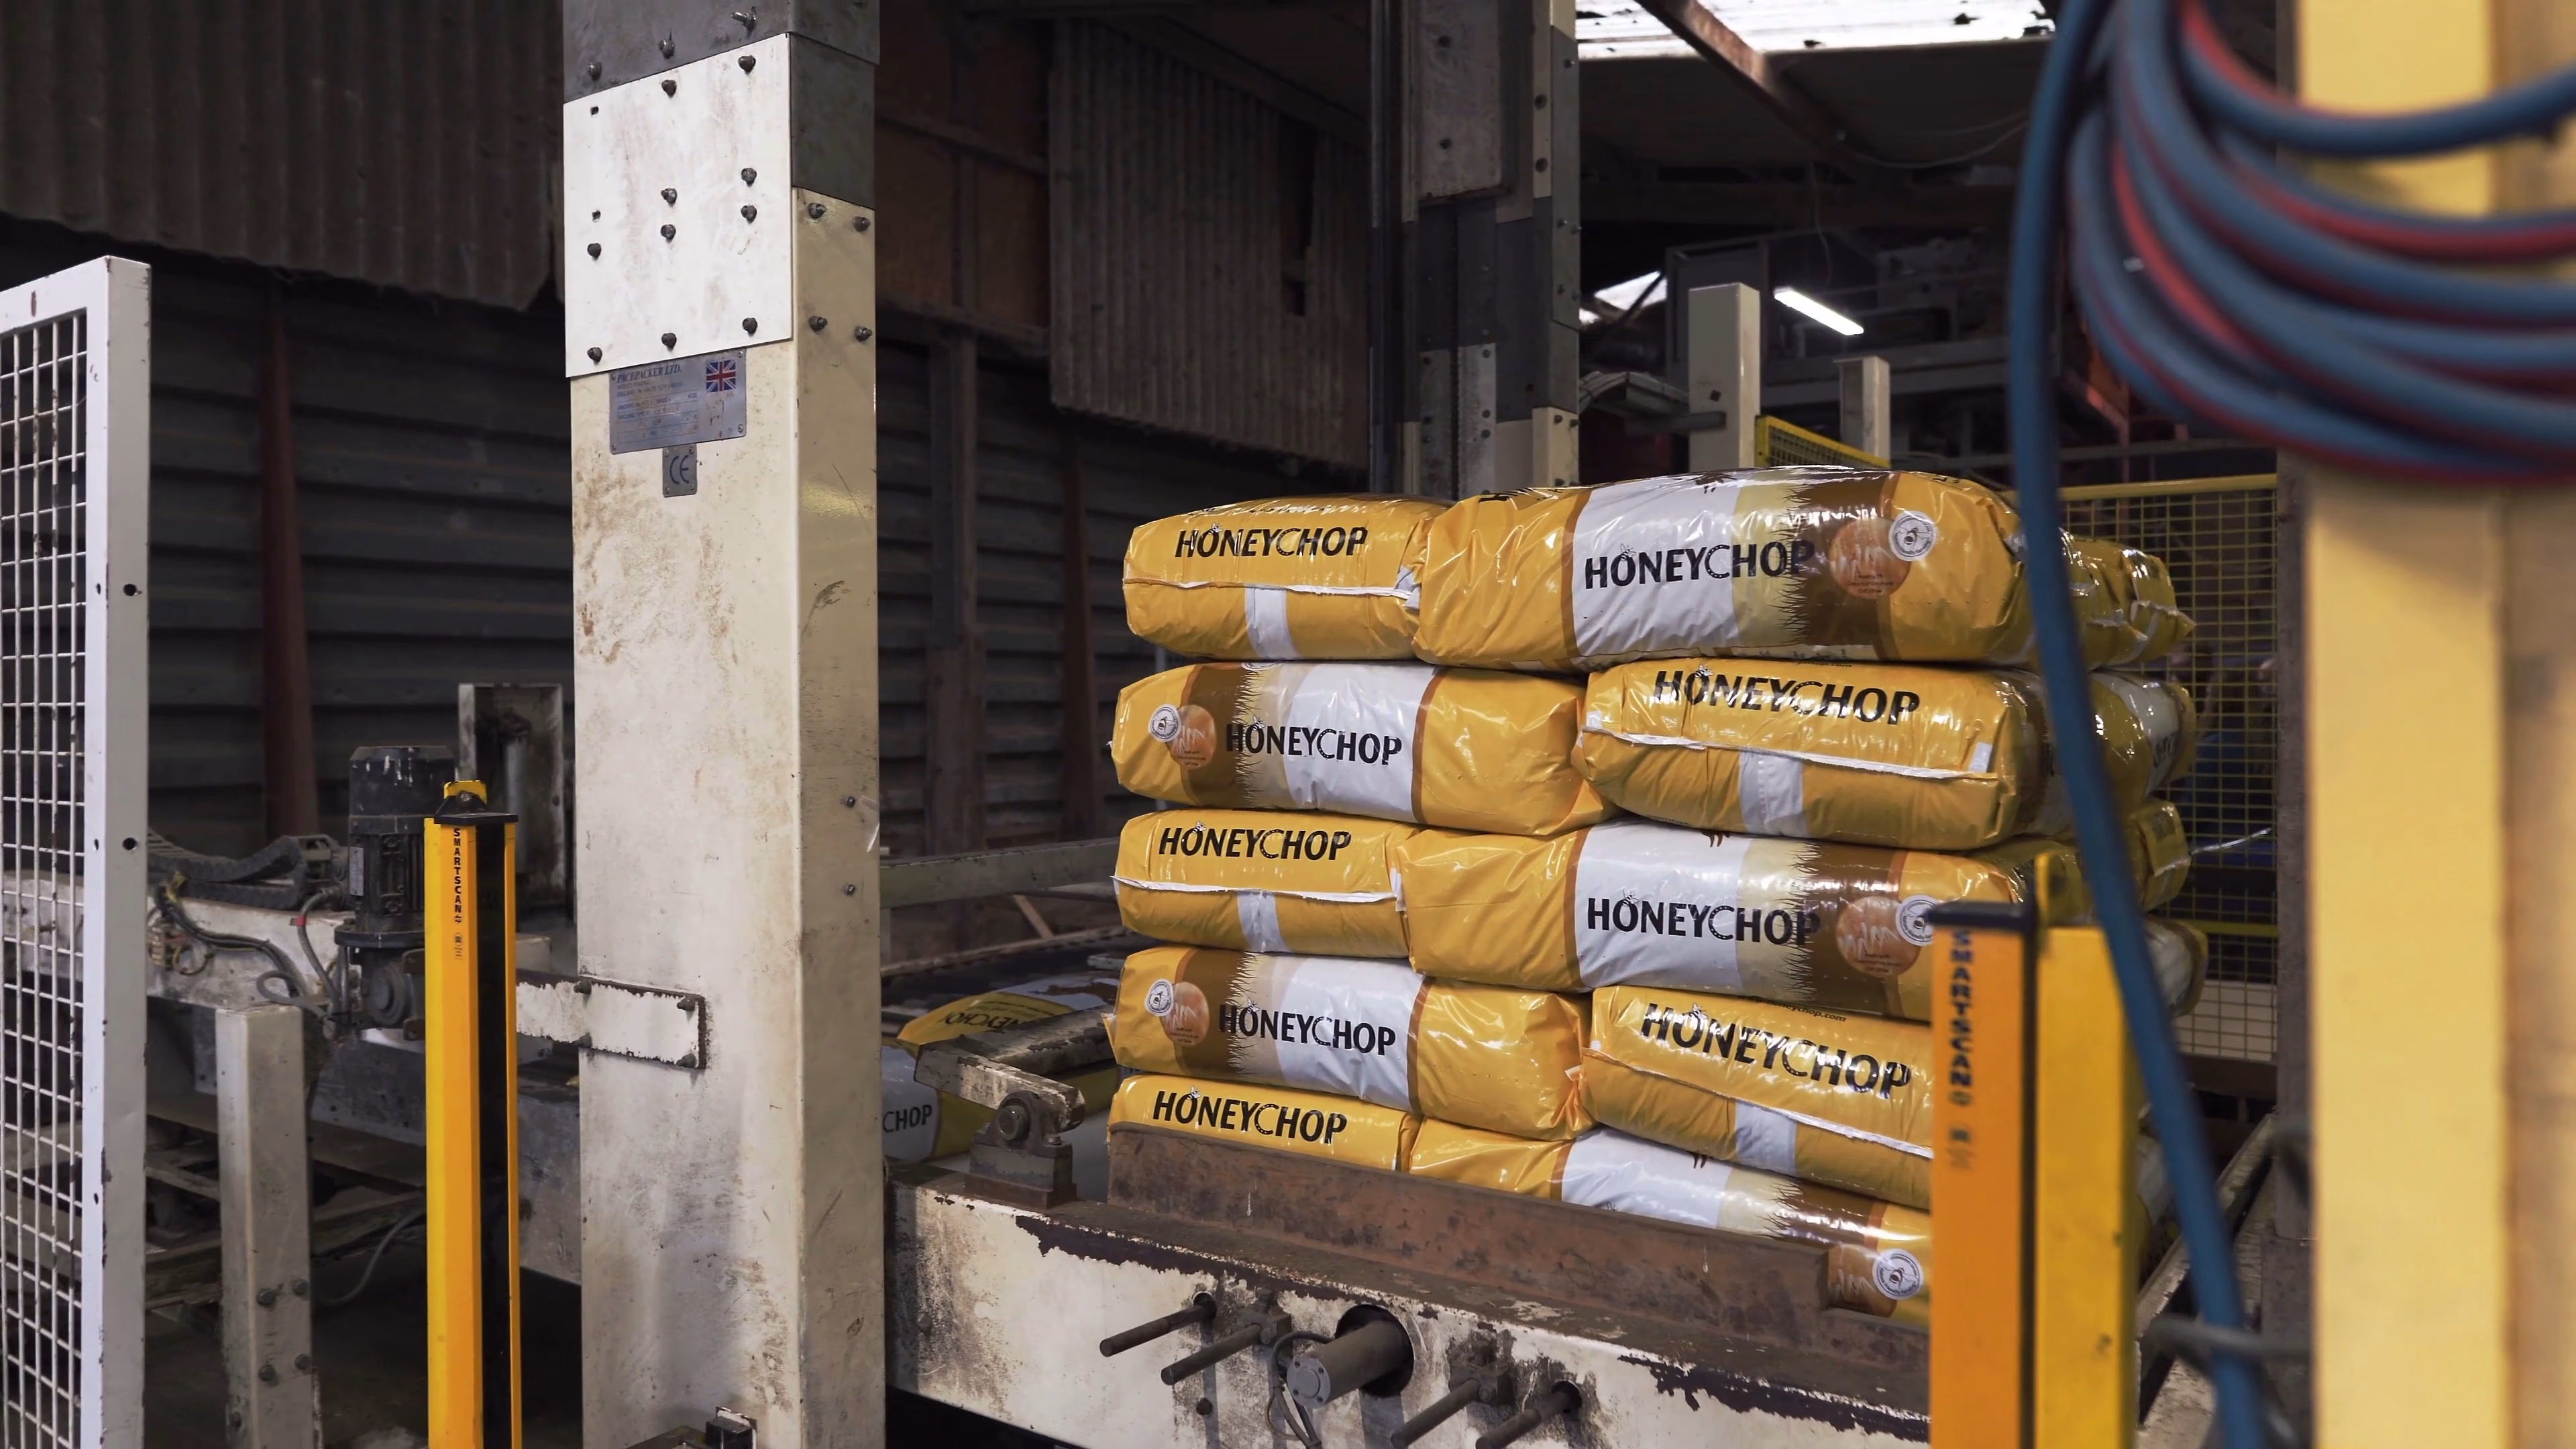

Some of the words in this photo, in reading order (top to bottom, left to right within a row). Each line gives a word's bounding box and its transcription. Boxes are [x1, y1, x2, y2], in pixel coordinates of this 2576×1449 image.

[616, 367, 663, 383] PACEPACKER
[664, 364, 682, 376] LTD.
[669, 455, 689, 484] CE
[1175, 527, 1368, 557] HONEYCHOP
[1584, 539, 1815, 589] HONEYCHOP
[1653, 670, 1920, 725] HONEYCHOP
[1226, 723, 1401, 765] HONEYCHOP
[1158, 827, 1351, 861] HONEYCHOP
[453, 828, 462, 913] SMARTSCAN
[1587, 897, 1820, 947] HONEYCHOP
[1219, 1004, 1396, 1056] HONEYCHOP
[1949, 929, 1974, 1087] SMARTSCAN
[1640, 1002, 1912, 1099] HONEYCHOP
[882, 1104, 932, 1132] CHOP
[1152, 1090, 1347, 1144] HONEYCHOP
